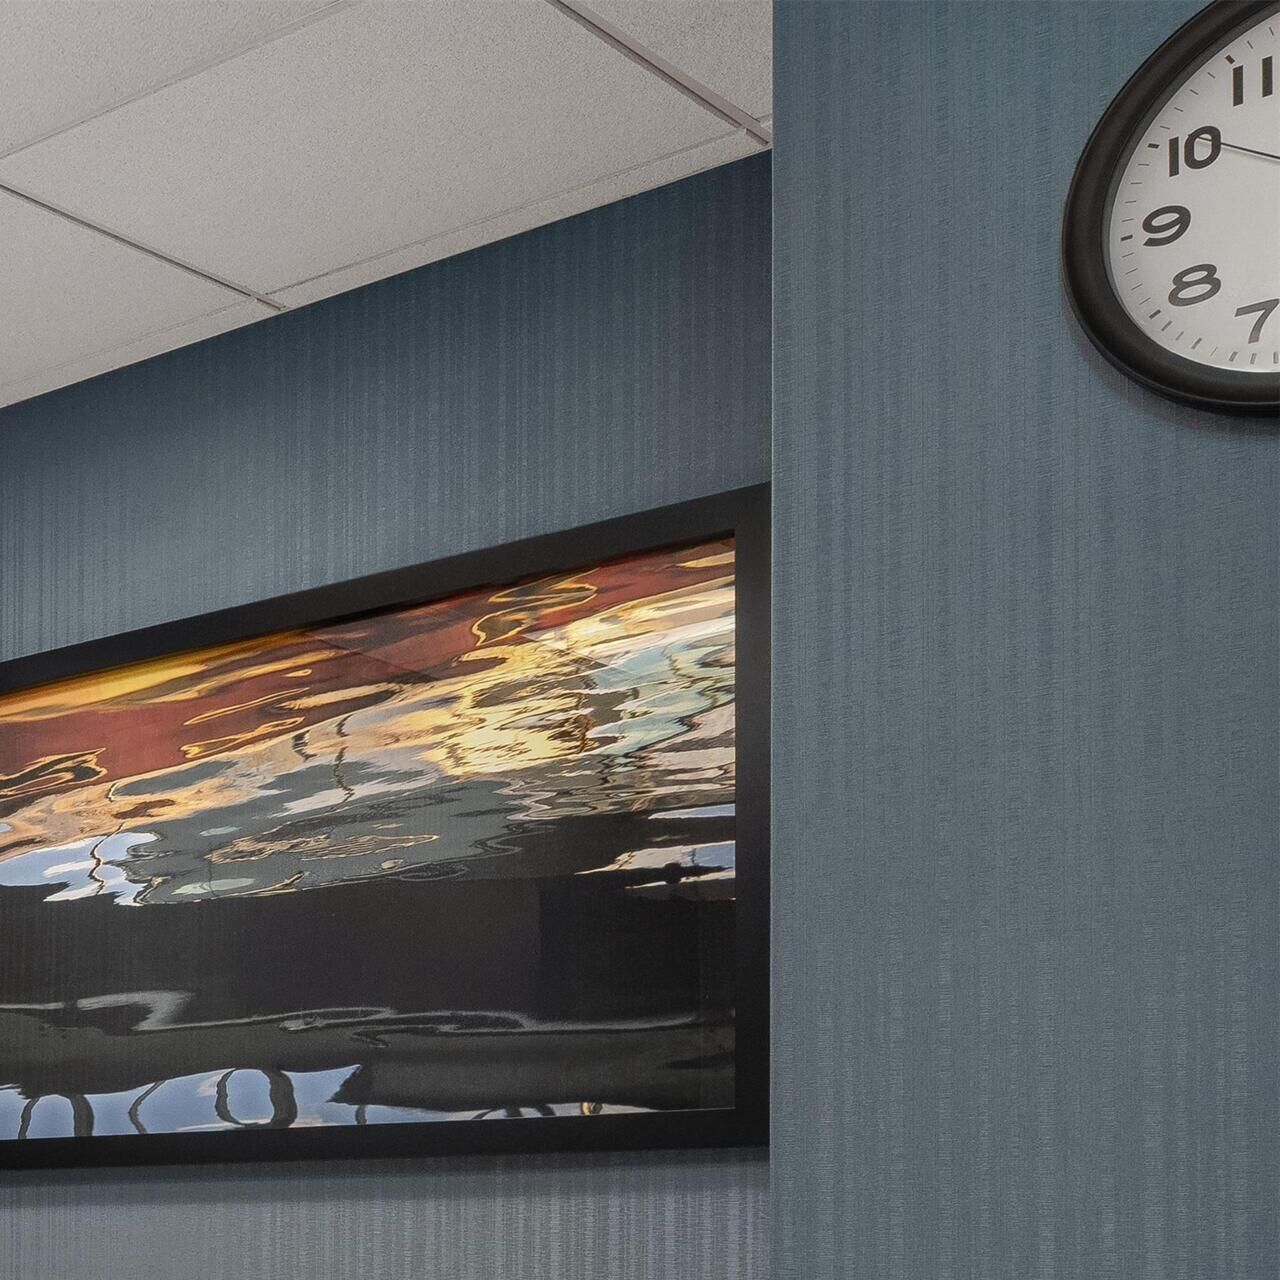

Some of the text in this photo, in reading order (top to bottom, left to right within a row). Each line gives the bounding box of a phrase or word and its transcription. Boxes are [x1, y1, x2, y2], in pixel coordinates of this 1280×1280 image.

[1232, 56, 1273, 107] 11
[1168, 125, 1222, 178] 10
[1142, 205, 1192, 247] 9
[1168, 264, 1221, 307] 8
[1234, 298, 1280, 345] 7
